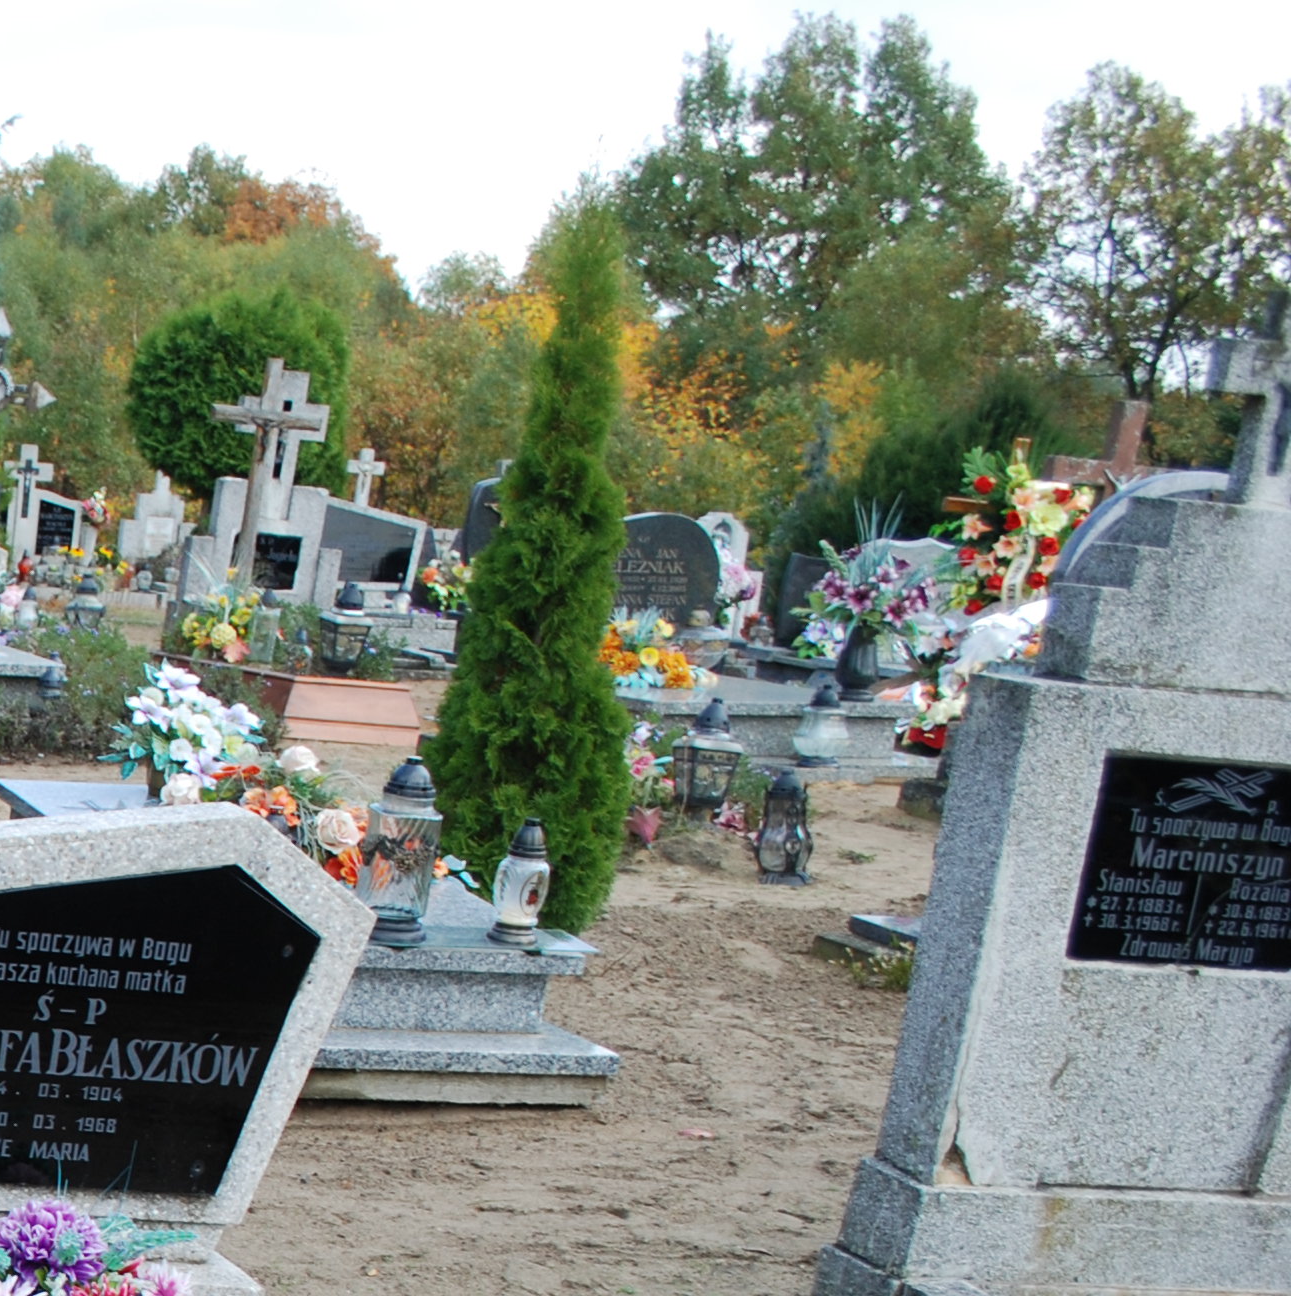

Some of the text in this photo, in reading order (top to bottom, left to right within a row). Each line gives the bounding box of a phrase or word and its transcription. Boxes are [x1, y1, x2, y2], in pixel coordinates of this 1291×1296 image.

[1130, 807, 1291, 847] Tu spoczywa w Bog
[1129, 836, 1285, 881] Marciniszyn
[1096, 869, 1183, 896] Stanisław
[16, 930, 114, 958] spoczywa
[119, 937, 137, 958] w
[141, 936, 192, 966] Bogu
[1120, 932, 1255, 966] Zdrowaś Maryjo
[45, 961, 120, 990] kochana
[124, 969, 187, 995] matka
[47, 1027, 259, 1088] BŁASZKÓW
[29, 1140, 91, 1163] MARIA
